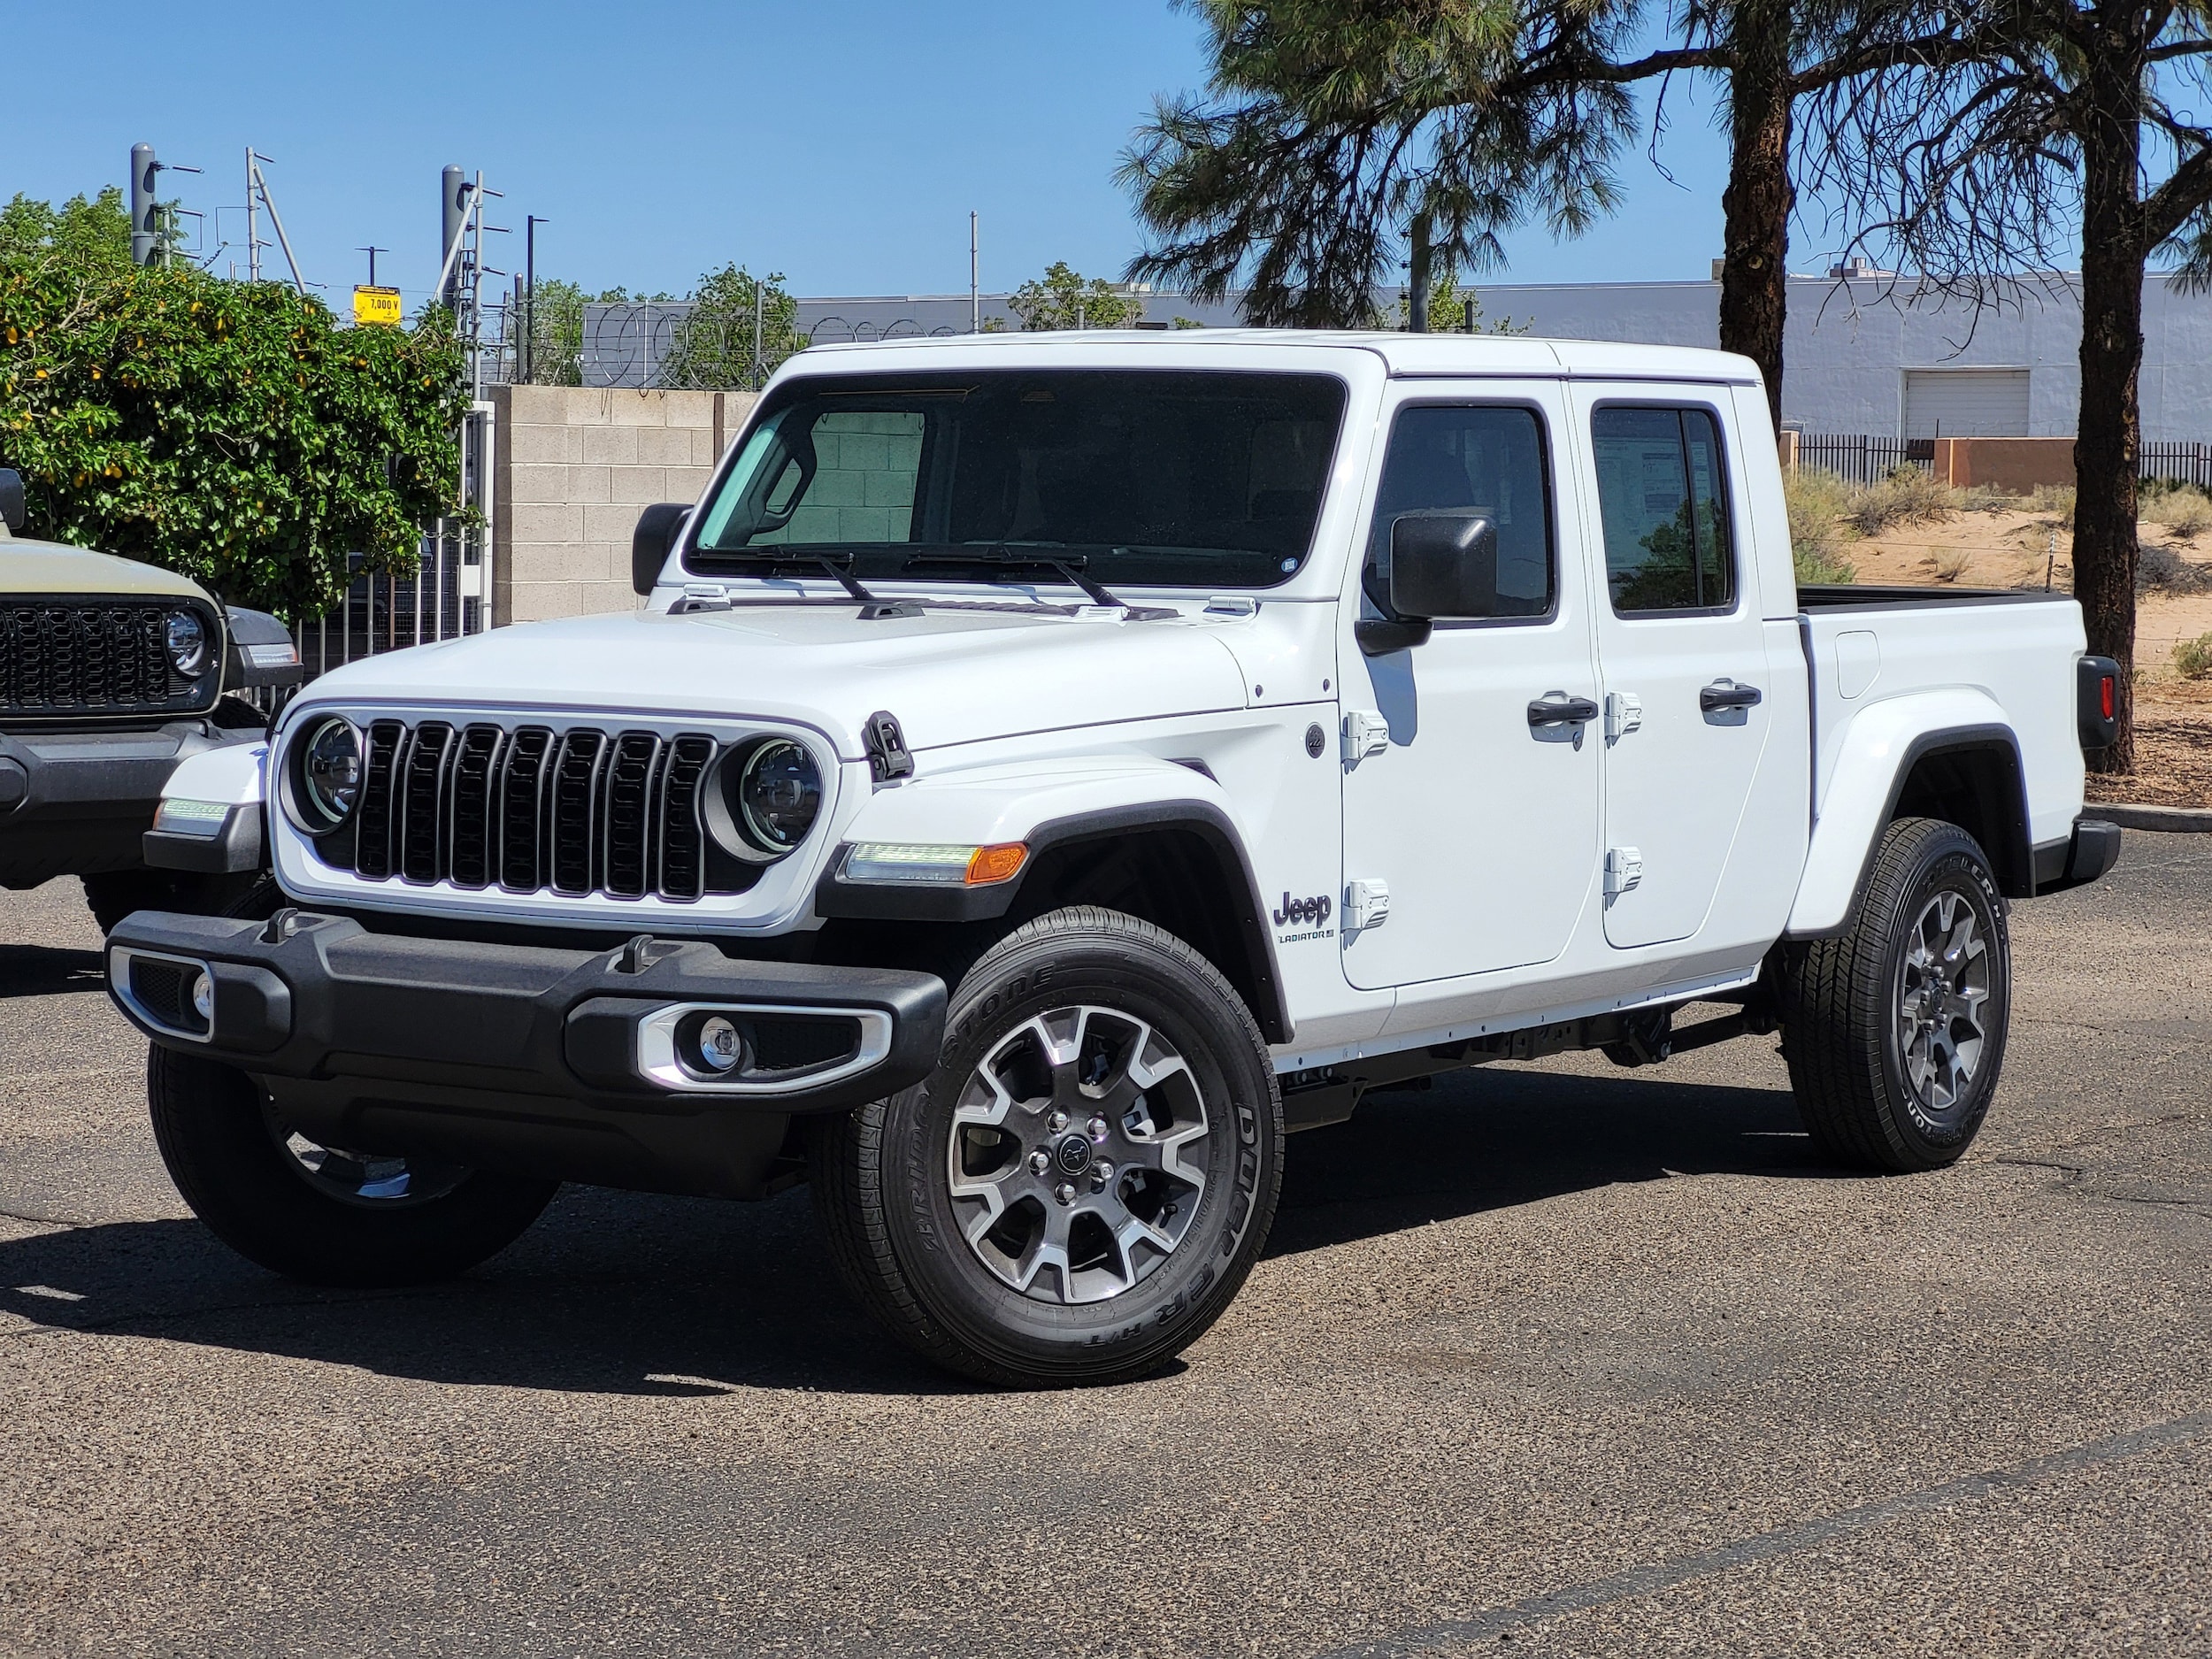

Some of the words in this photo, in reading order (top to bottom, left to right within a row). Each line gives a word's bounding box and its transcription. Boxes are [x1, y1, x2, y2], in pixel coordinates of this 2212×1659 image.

[371, 298, 391, 310] 7,000
[393, 300, 398, 311] V
[1274, 891, 1331, 929] Jeep
[1278, 930, 1325, 944] LADIATOR
[1154, 1102, 1257, 1326] DUELER
[1084, 1322, 1142, 1348] H/T
